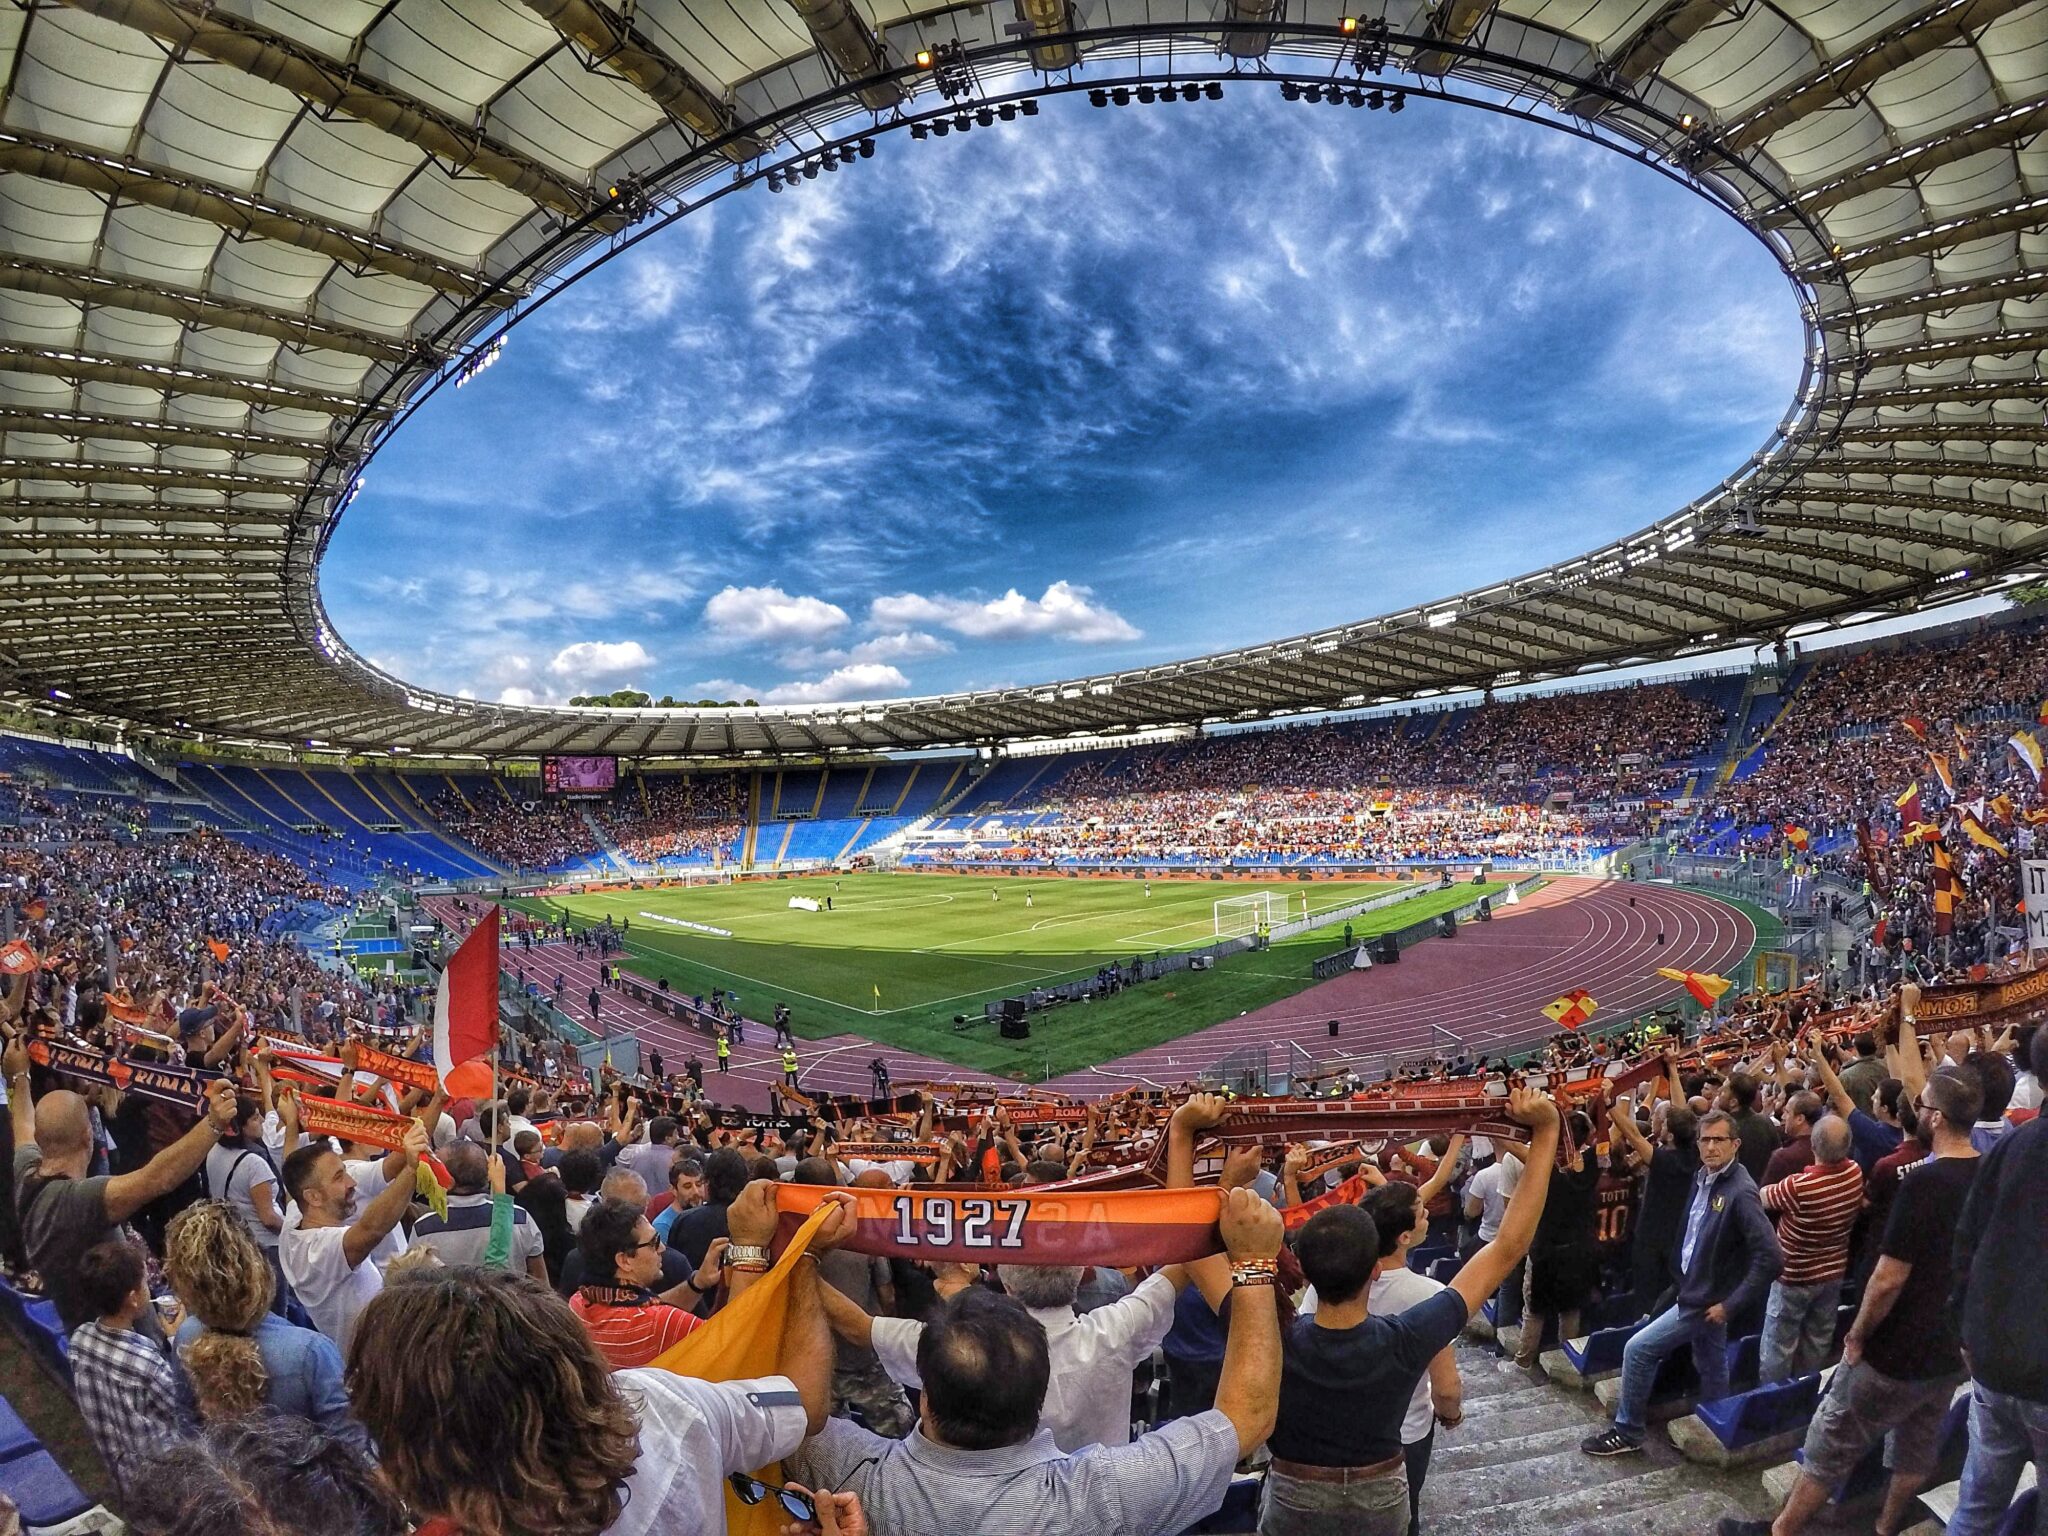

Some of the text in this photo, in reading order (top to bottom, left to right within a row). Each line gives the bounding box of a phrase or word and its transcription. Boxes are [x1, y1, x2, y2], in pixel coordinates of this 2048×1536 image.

[1054, 1107, 1088, 1118] ROMA
[893, 1196, 1030, 1248] 1927
[1597, 1205, 1629, 1241] 10
